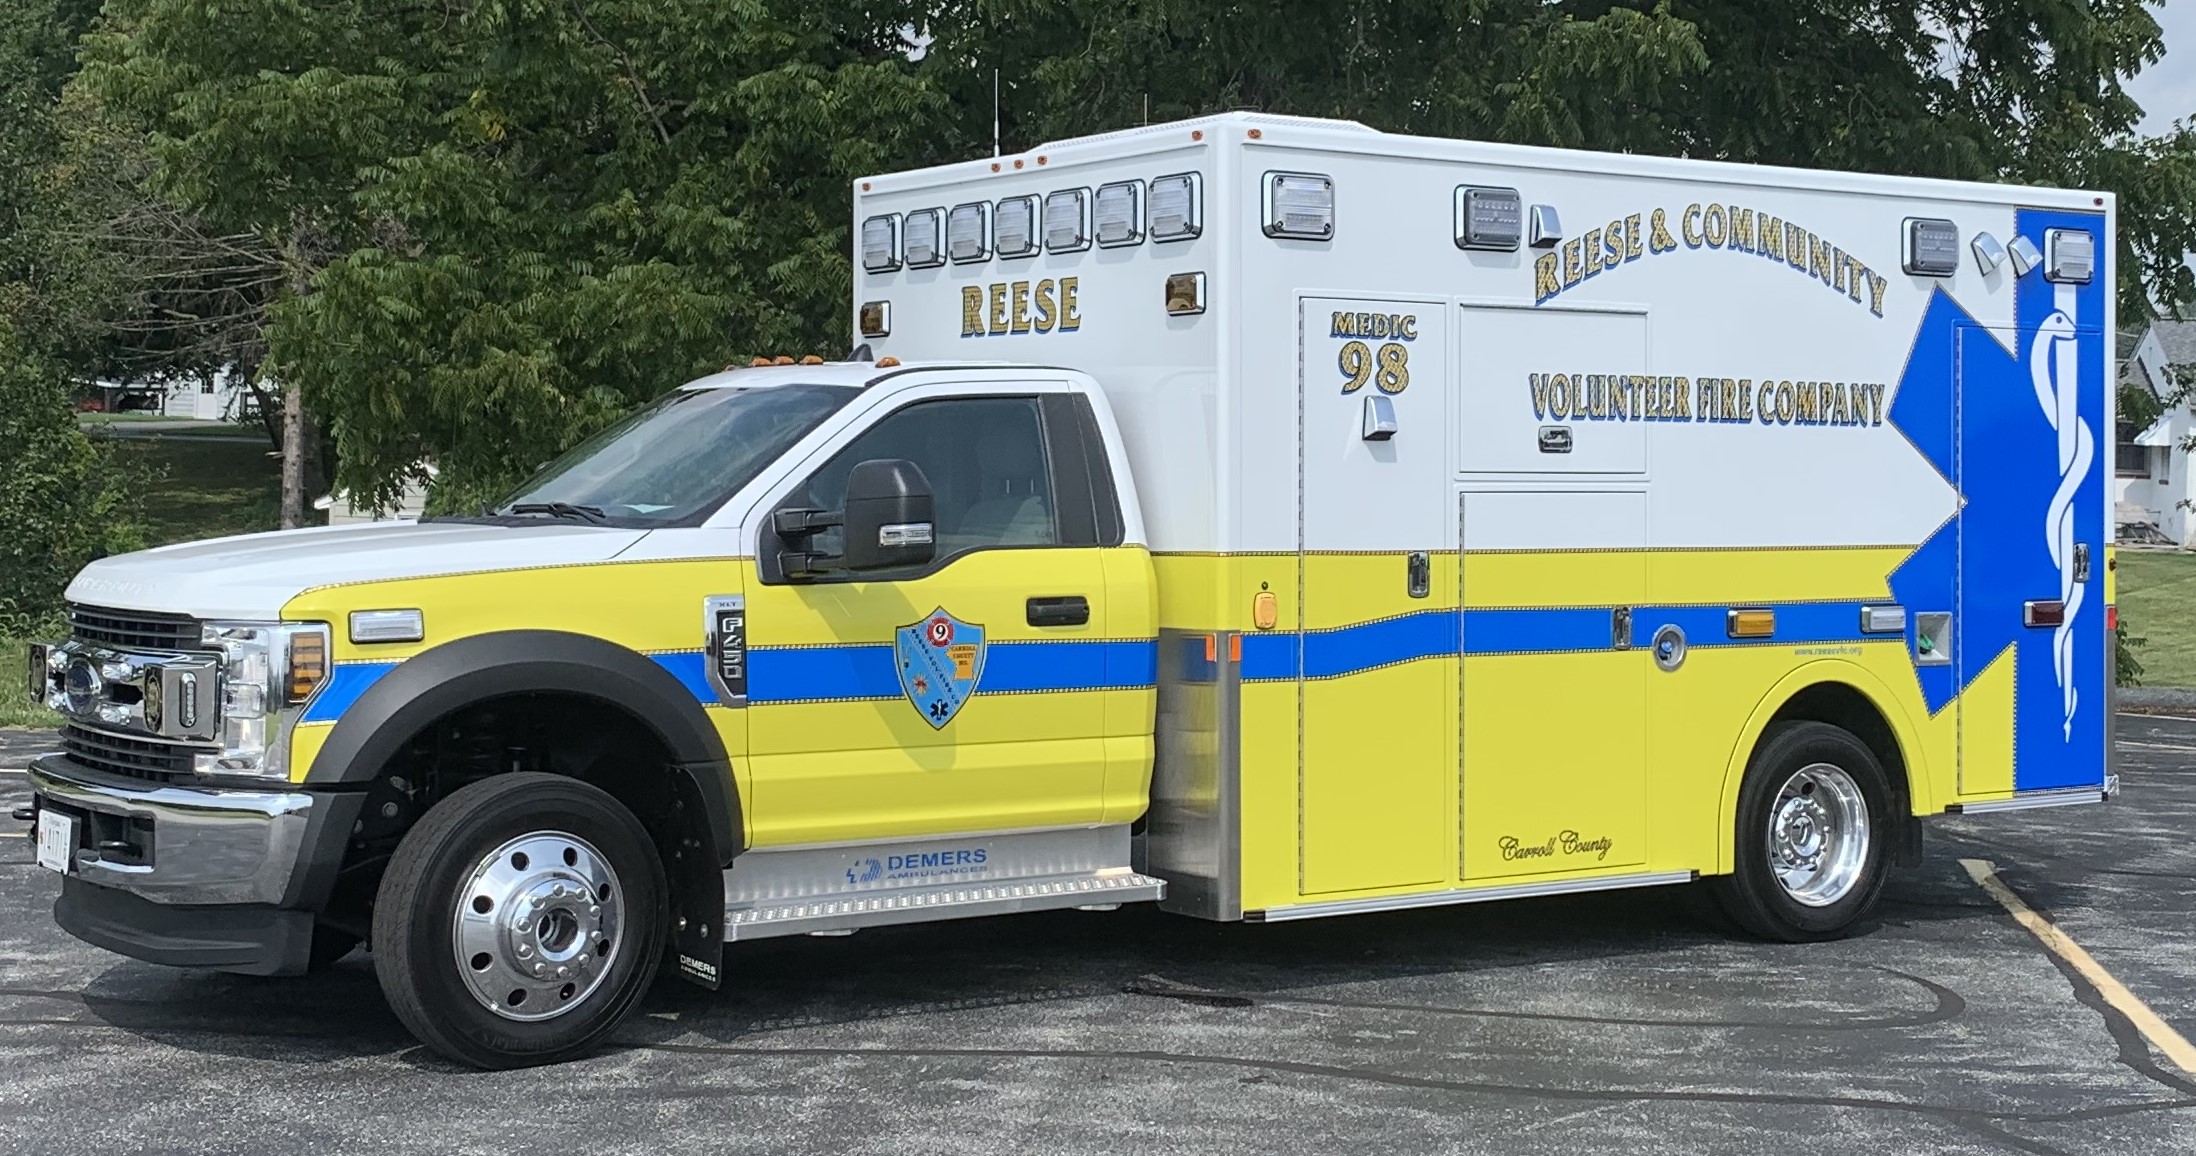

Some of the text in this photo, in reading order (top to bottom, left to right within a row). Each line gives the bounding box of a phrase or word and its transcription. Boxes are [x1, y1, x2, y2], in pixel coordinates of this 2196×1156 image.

[1534, 203, 1888, 319] REESE & COMMUNITY
[960, 276, 1081, 338] REESE
[1330, 311, 1417, 342] MEDIC
[1338, 341, 1409, 396] 98
[1528, 373, 1886, 428] VOLUNTEER FIRE COMPANY
[936, 625, 946, 639] 9
[888, 849, 987, 871] DEMERS
[1499, 829, 1613, 861] Carroll County
[887, 866, 988, 879] AMBULANCES
[680, 954, 717, 976] DEMERS
